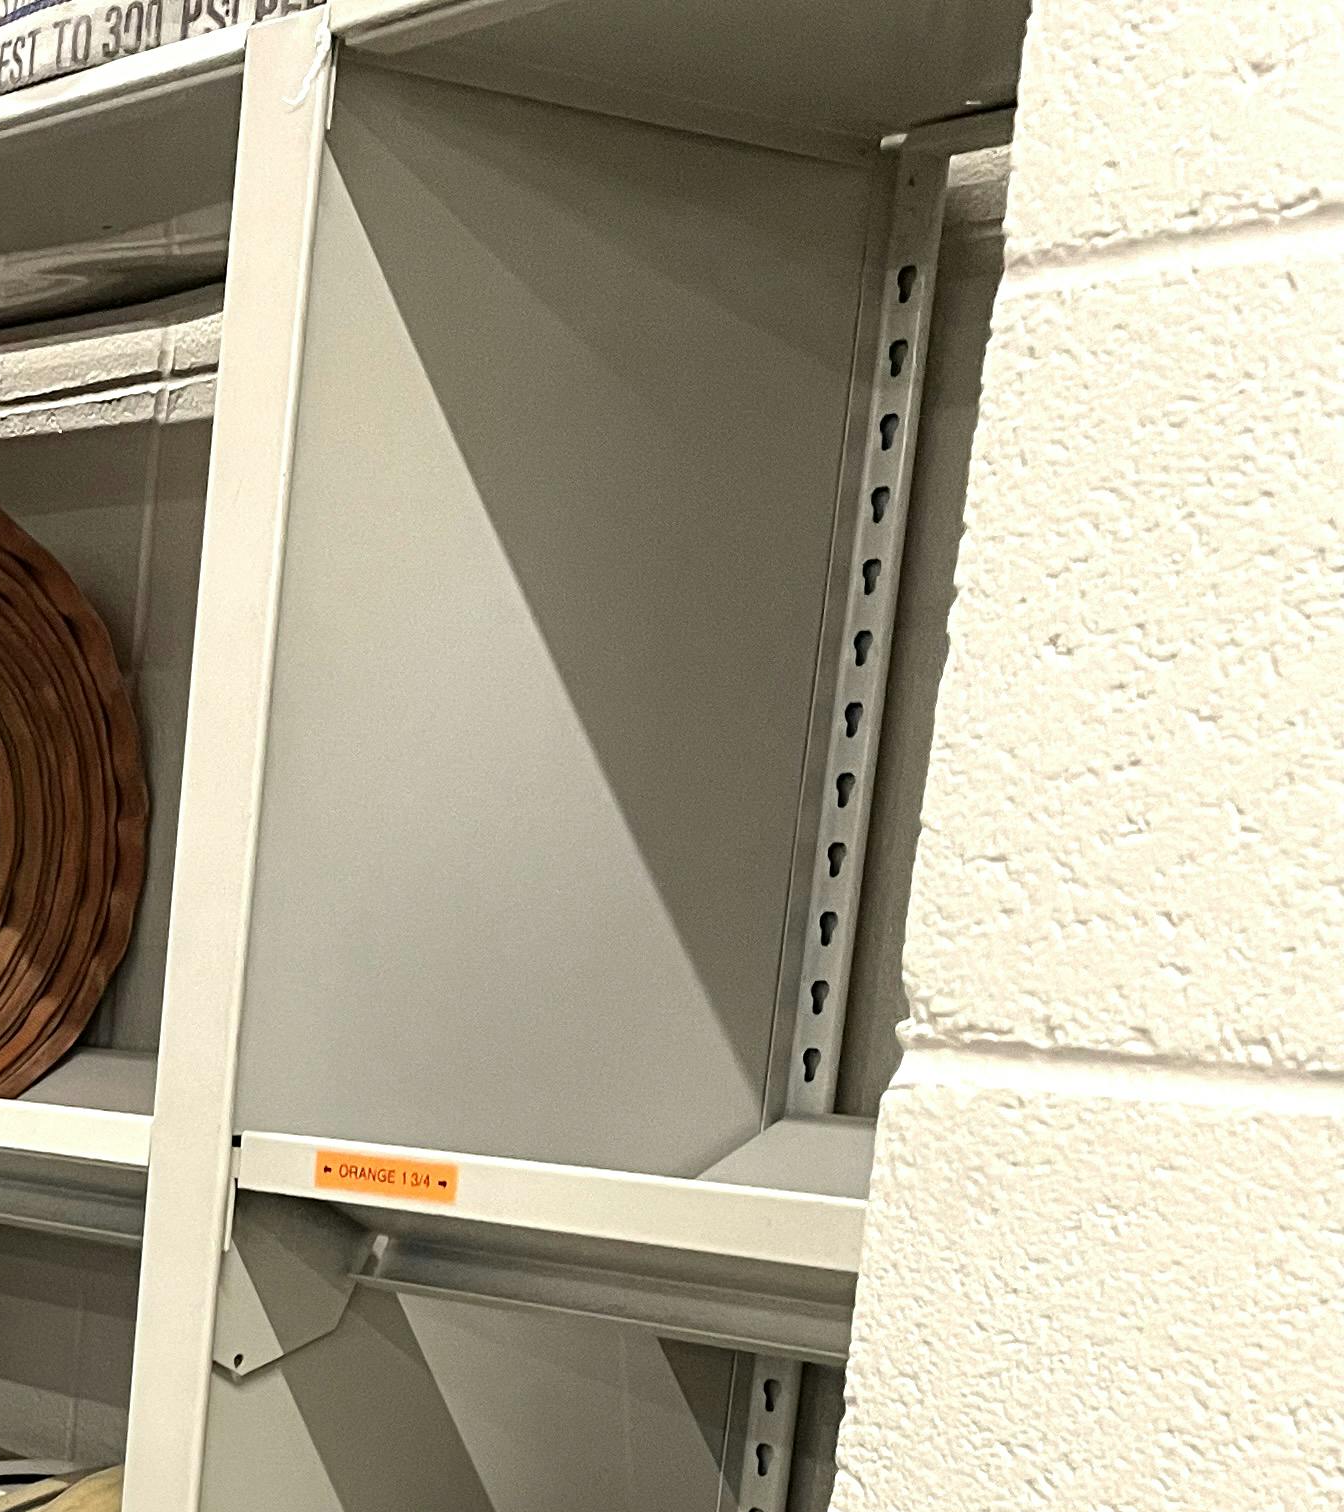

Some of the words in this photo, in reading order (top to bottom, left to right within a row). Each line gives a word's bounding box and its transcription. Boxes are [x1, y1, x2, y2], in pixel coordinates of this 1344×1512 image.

[52, 15, 93, 72] TO
[101, 0, 162, 58] 300
[338, 1163, 396, 1185] ORANGE
[410, 1172, 432, 1189] 3/4
